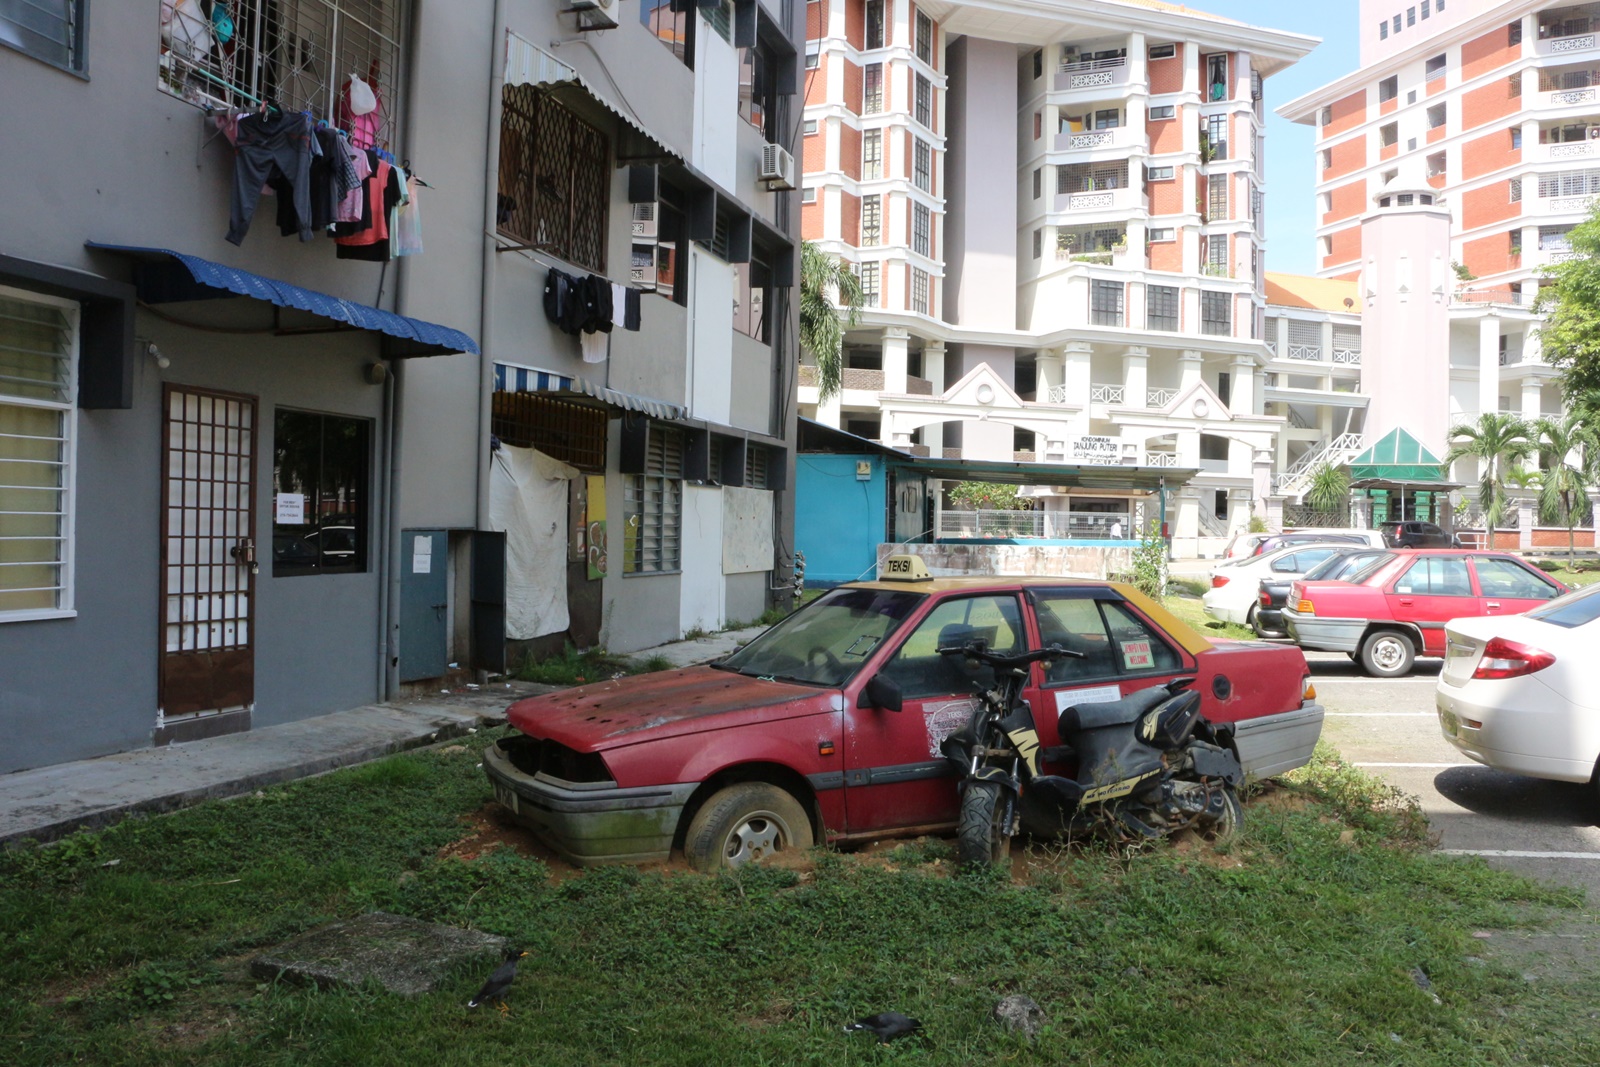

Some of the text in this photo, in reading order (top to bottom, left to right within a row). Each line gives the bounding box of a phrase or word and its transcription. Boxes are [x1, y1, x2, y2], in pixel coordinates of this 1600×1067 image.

[1074, 442, 1097, 450] TANJUNG
[888, 560, 911, 572] TEKSI
[1129, 654, 1149, 665] WELCOME
